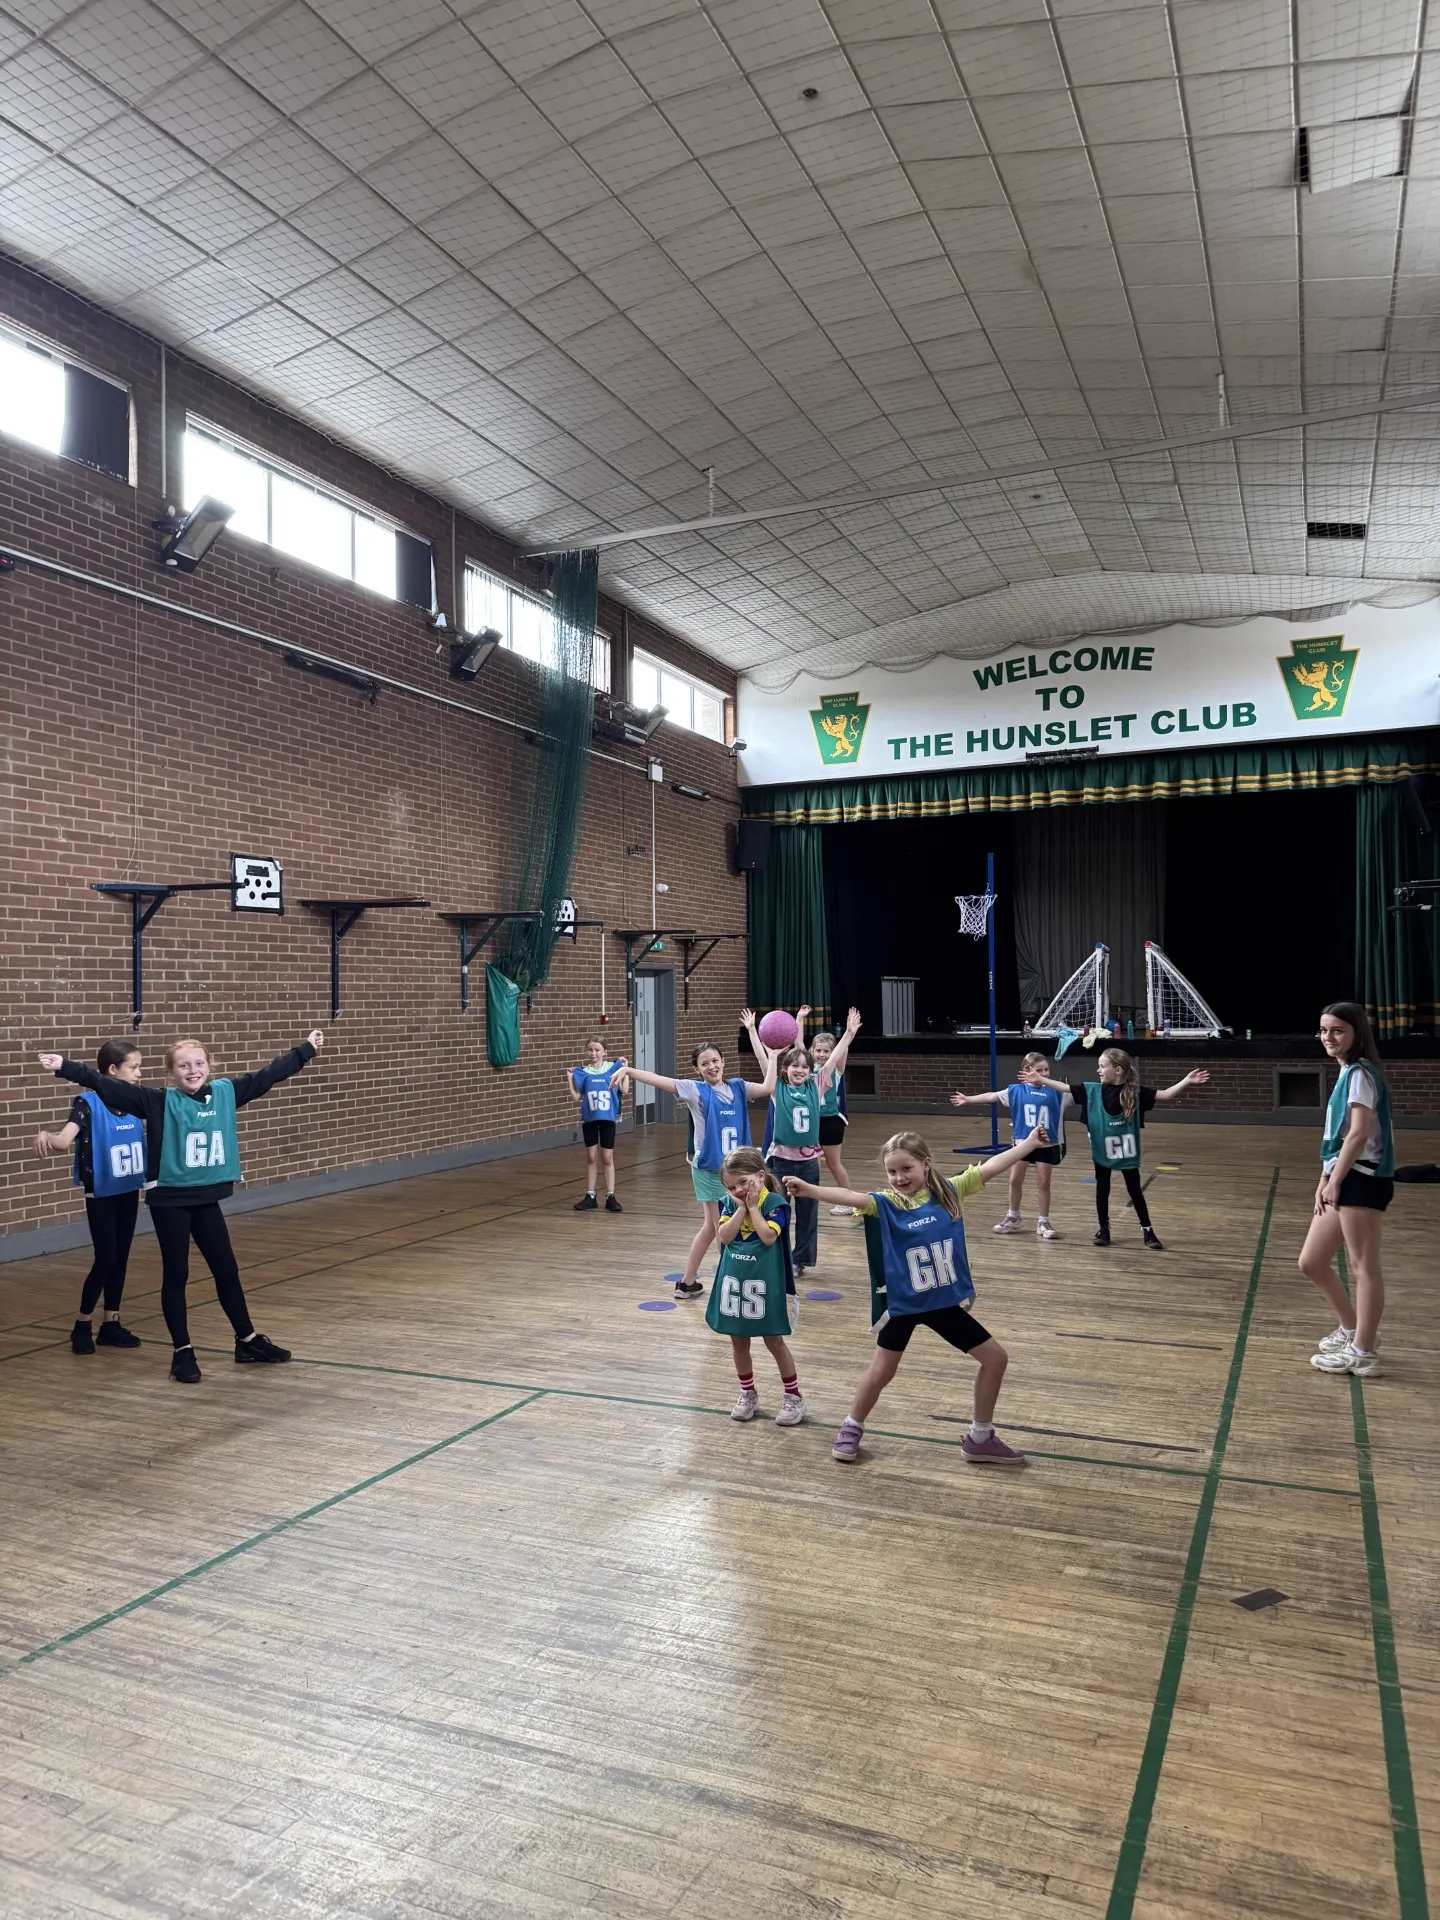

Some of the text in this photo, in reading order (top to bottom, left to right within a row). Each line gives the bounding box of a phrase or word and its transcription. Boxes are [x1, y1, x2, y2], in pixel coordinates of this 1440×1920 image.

[973, 647, 1155, 691] WELCOME
[1035, 685, 1085, 711] TO
[887, 702, 1257, 760] THE HUNSLET CLUB
[587, 1090, 611, 1112] GS
[792, 1106, 810, 1133] C
[1023, 1103, 1050, 1129] GA
[110, 1141, 144, 1178] GD
[185, 1130, 226, 1168] GA
[1104, 1133, 1137, 1160] GD
[907, 1215, 938, 1230] FORZA
[731, 1252, 757, 1262] FORZA
[905, 1237, 958, 1293] GK
[719, 1274, 767, 1320] GS
